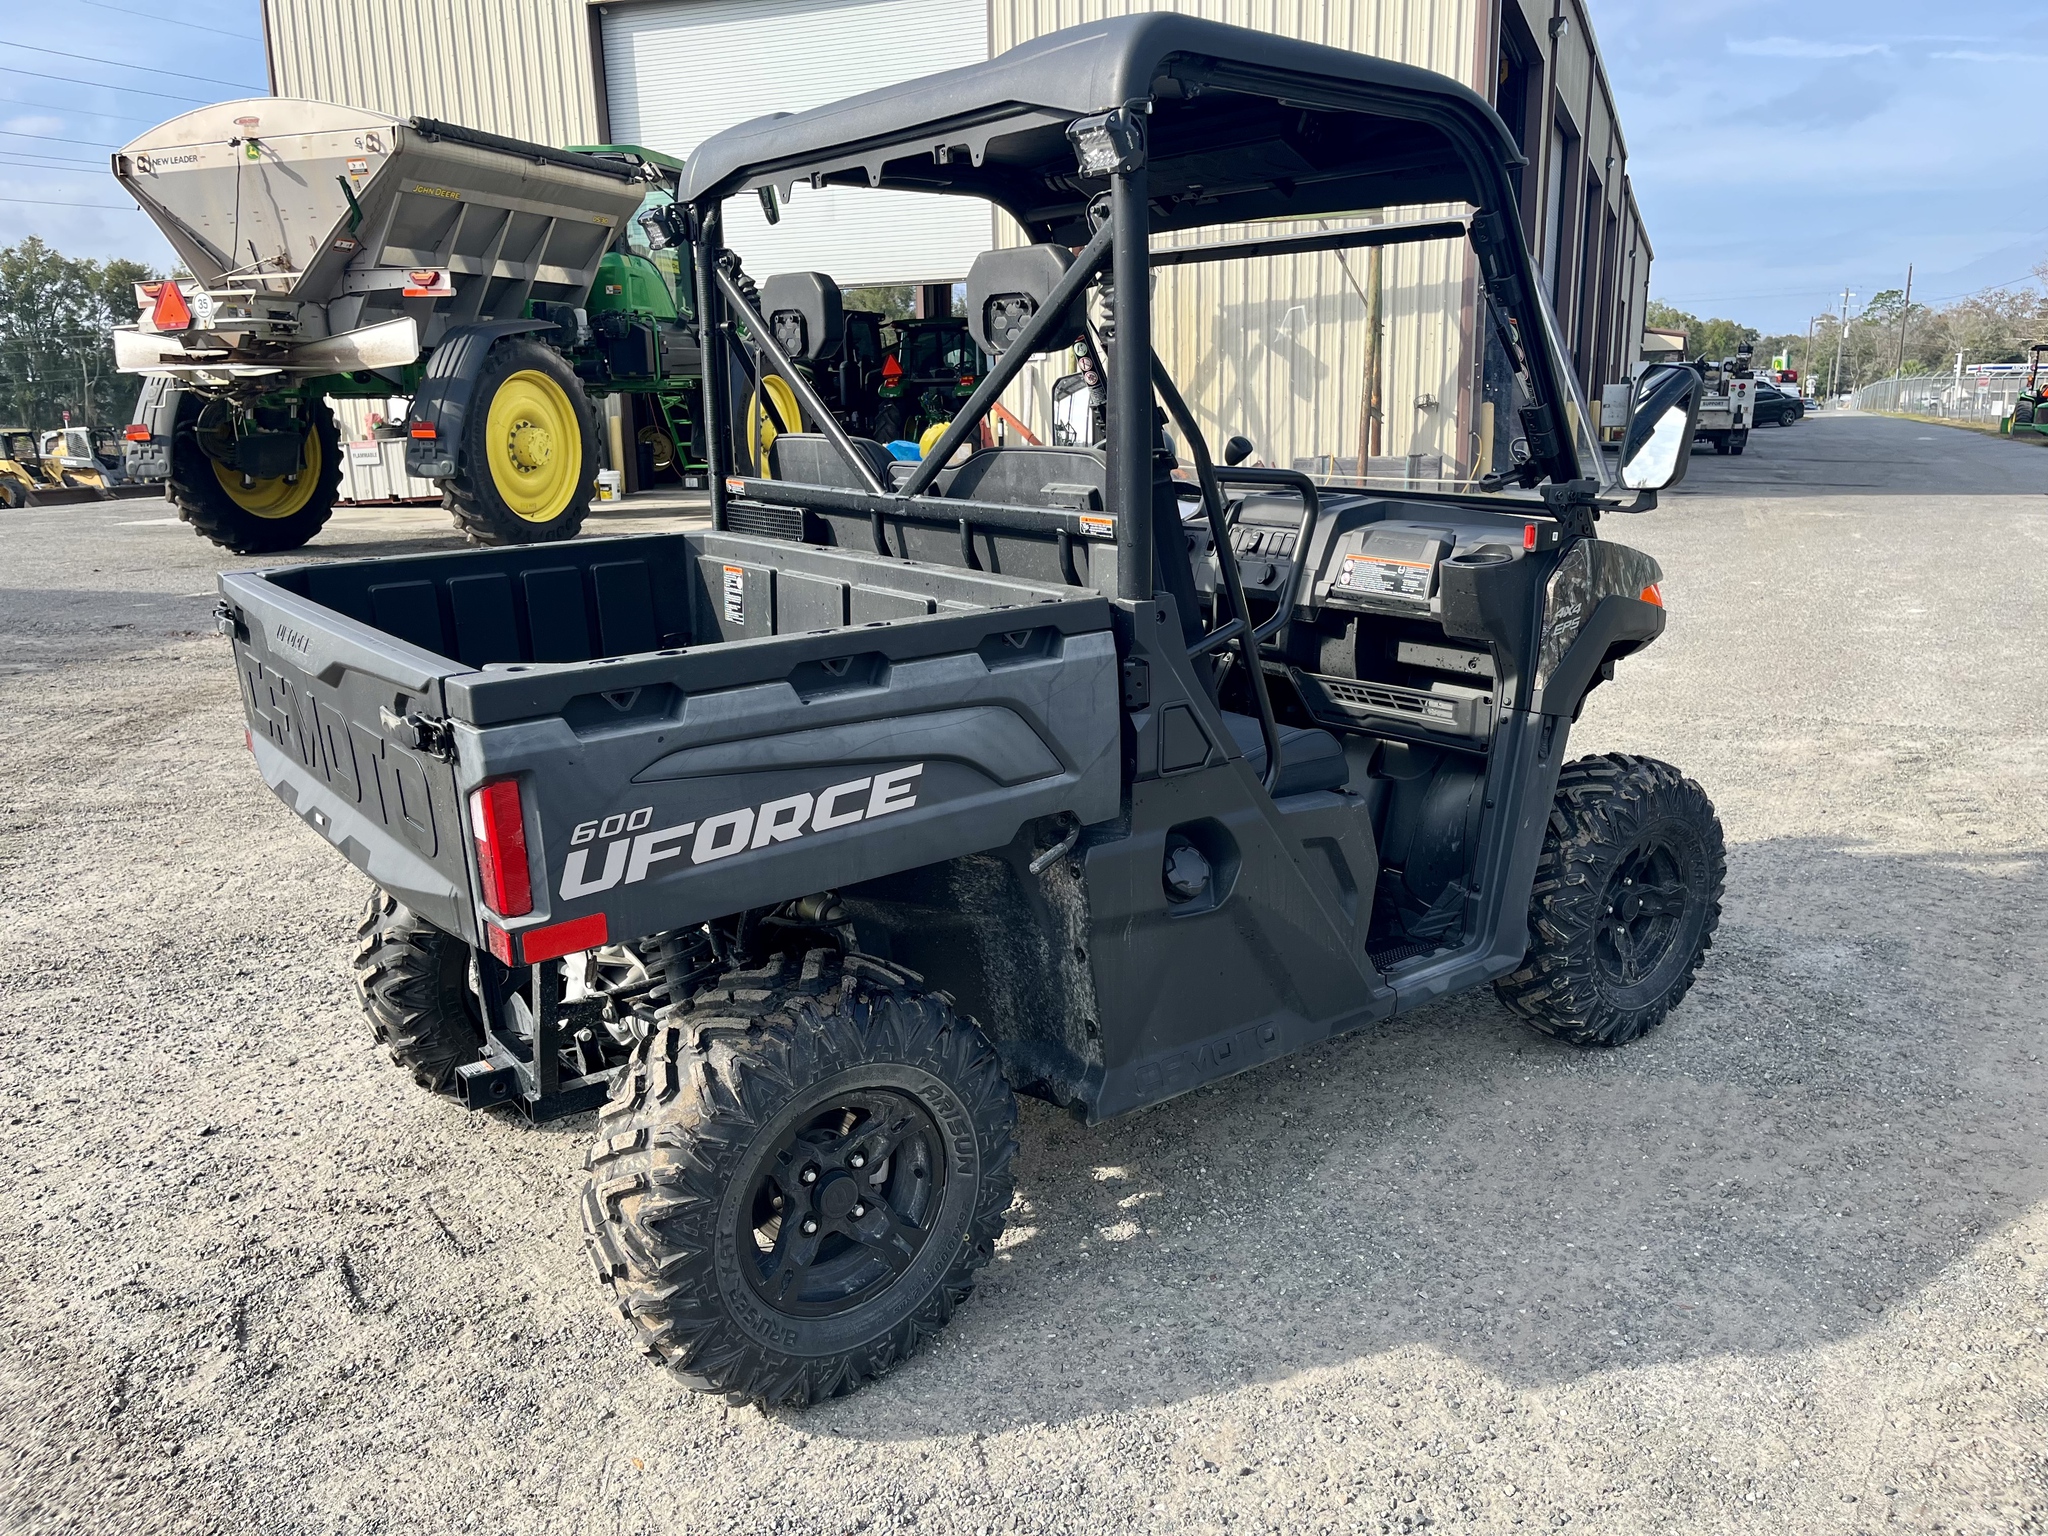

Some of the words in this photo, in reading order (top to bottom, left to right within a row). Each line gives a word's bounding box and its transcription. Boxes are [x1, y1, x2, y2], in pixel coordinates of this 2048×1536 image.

[151, 157, 171, 166] NEW
[170, 155, 198, 165] LEADER
[412, 184, 435, 196] JOHN
[435, 187, 460, 200] DEERE
[198, 299, 209, 309] 35
[1553, 616, 1581, 637] EPS
[558, 763, 924, 901] UFORCE
[570, 806, 654, 846] 600
[1134, 1020, 1283, 1095] CFMOTO
[916, 1084, 974, 1176] ARISUN
[727, 1277, 798, 1347] BRUISER
